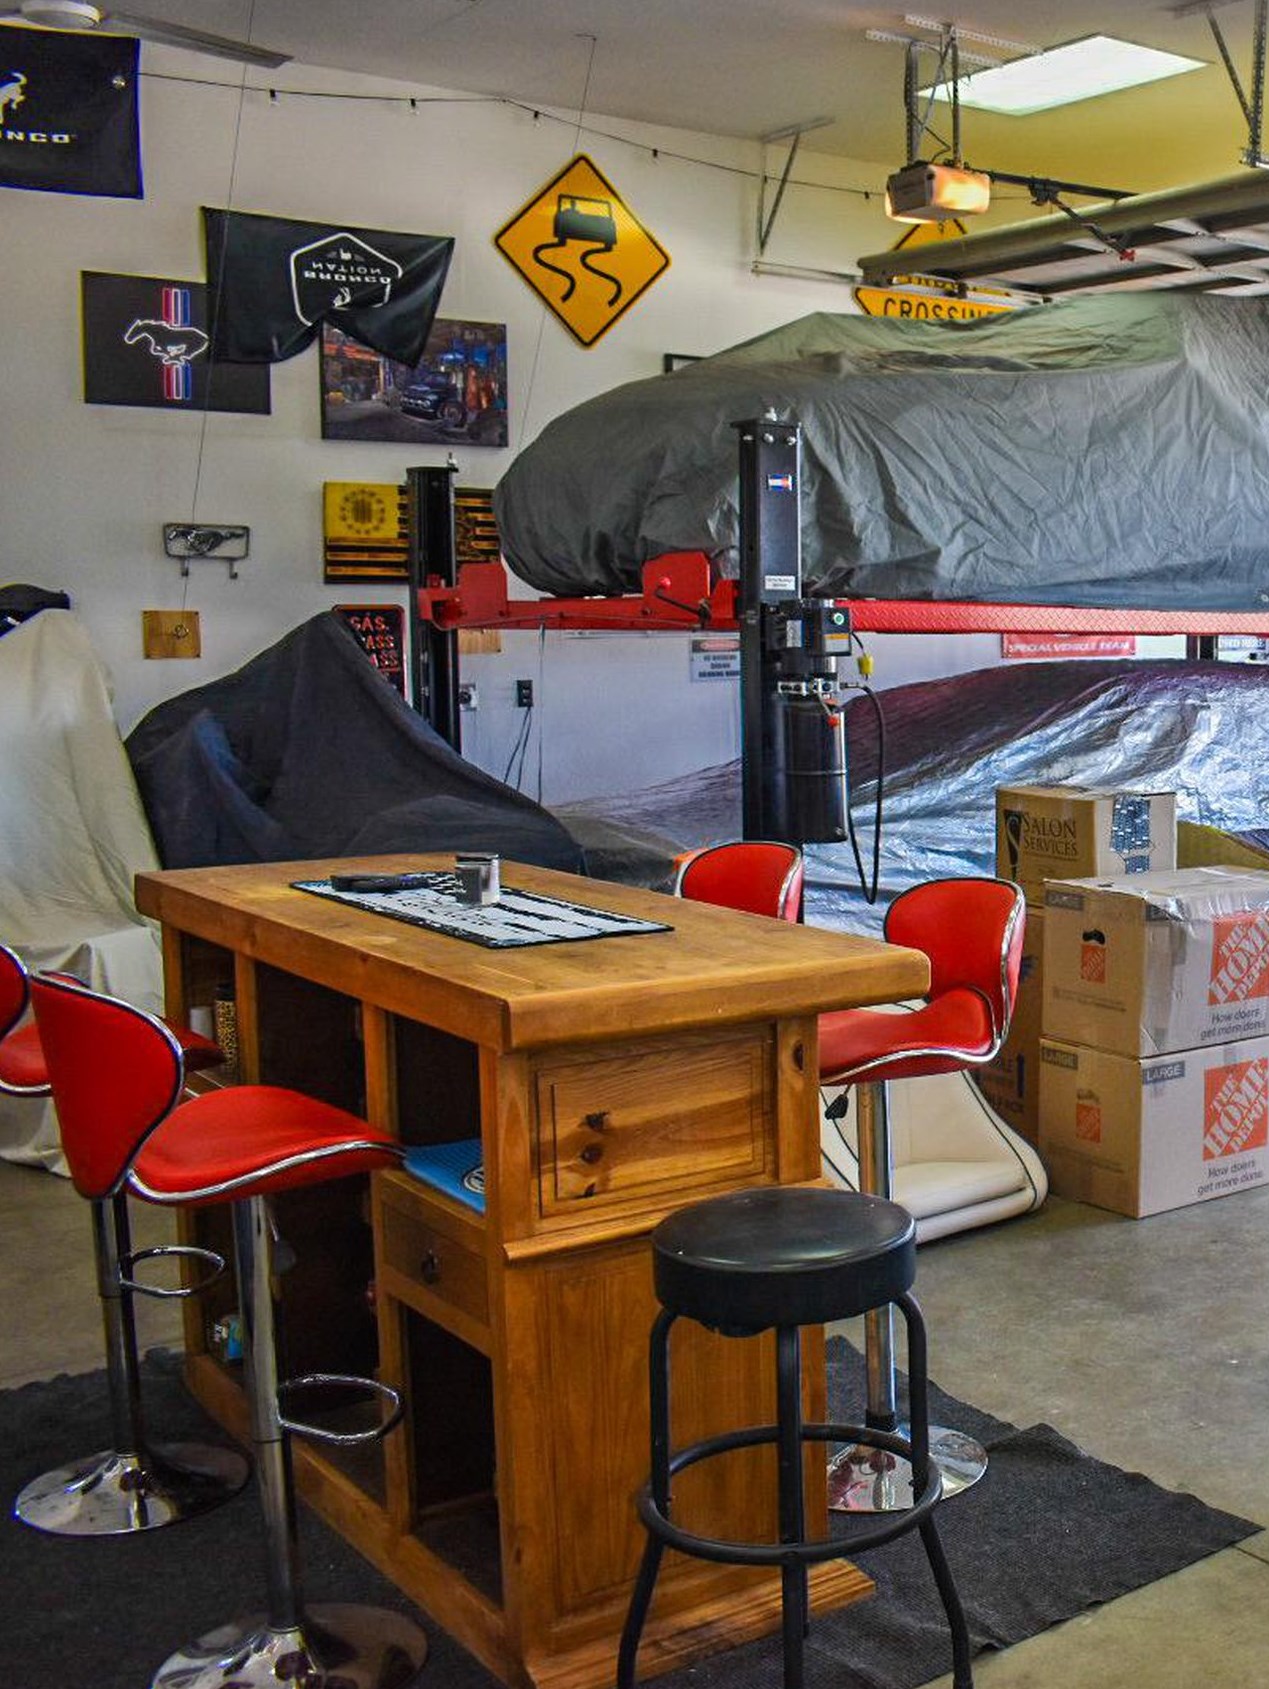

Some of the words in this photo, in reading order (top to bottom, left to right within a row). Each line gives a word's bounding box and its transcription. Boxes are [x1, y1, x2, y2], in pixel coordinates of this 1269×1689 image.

[0, 130, 70, 144] NCO
[884, 297, 993, 319] CROSSIN
[1023, 812, 1077, 839] SALON
[1023, 836, 1078, 856] SERVICES
[1211, 1012, 1234, 1023] How
[1200, 1027, 1216, 1041] get
[1146, 1065, 1182, 1082] LARGE
[1212, 1073, 1240, 1111] THE
[1203, 1058, 1268, 1157] HOME
[1230, 1094, 1268, 1152] DEPOT
[1208, 1166, 1229, 1178] How
[1197, 1182, 1214, 1196] get
